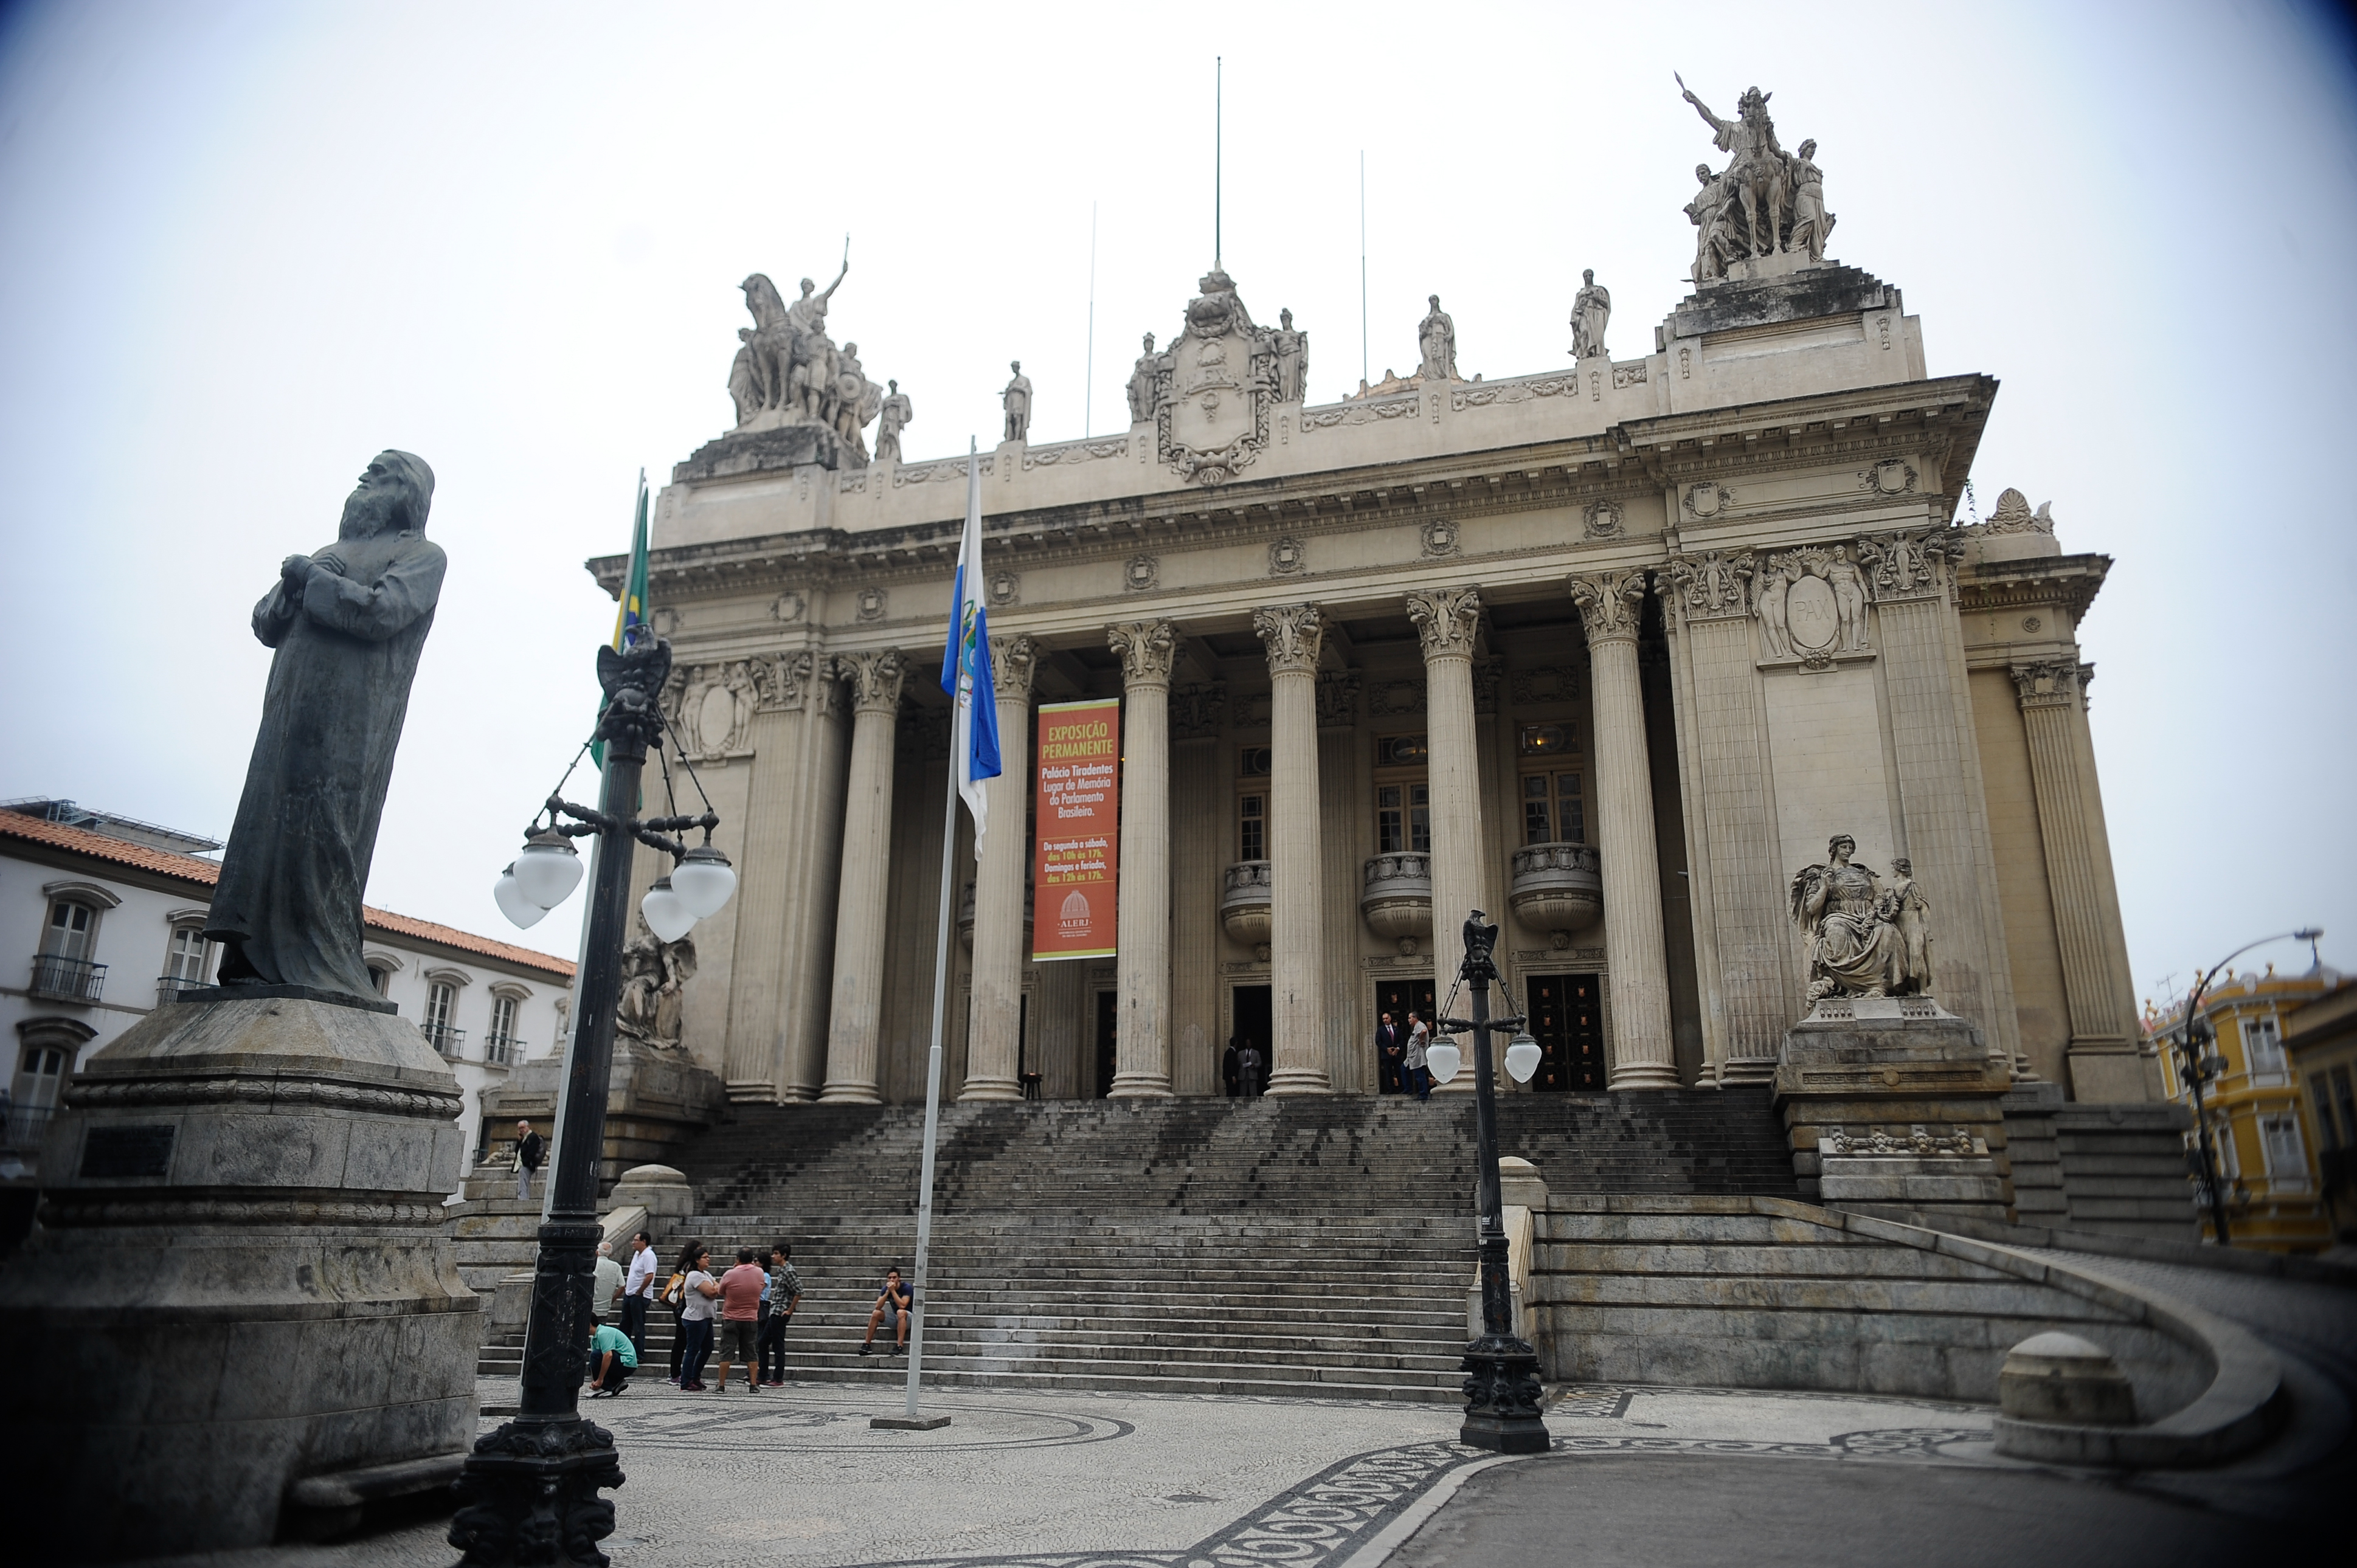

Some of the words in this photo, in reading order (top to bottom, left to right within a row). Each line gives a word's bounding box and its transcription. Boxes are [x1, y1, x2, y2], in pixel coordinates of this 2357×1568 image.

[1795, 598, 1829, 621] PAX
[1049, 720, 1107, 742] EXPOSIÇÃO
[1043, 739, 1113, 759] PERMANENTE
[1042, 765, 1070, 779] Palácio
[1072, 763, 1113, 776] Tiradentes
[1044, 781, 1064, 793] Lugar
[1066, 779, 1075, 790] de
[1078, 777, 1111, 789] Memória
[1050, 792, 1059, 805] do
[1062, 792, 1104, 804] Parlamento
[1058, 805, 1095, 819] Brasileiro.
[1044, 842, 1052, 851] De
[1053, 840, 1078, 852] segunda
[1048, 852, 1060, 861] das
[1062, 851, 1076, 860] 10h
[1045, 863, 1073, 872] Domingos
[1047, 874, 1059, 883] das
[1062, 872, 1076, 882] 12h
[1061, 919, 1089, 928] ALERJ
